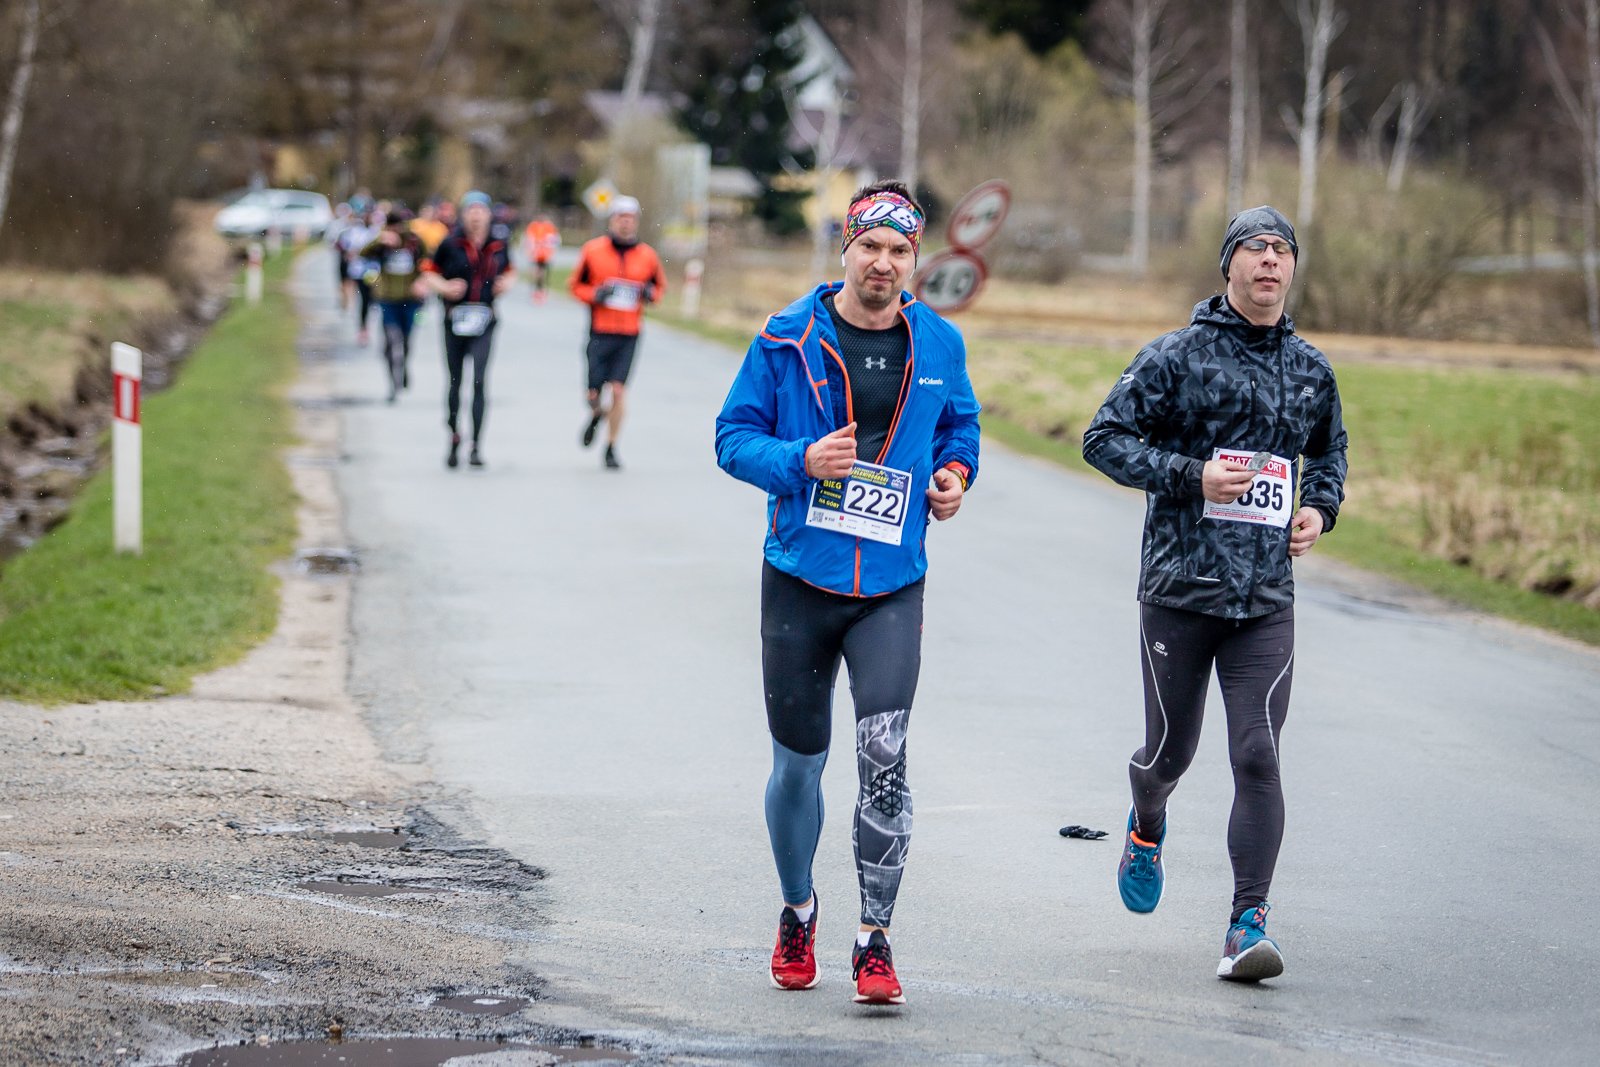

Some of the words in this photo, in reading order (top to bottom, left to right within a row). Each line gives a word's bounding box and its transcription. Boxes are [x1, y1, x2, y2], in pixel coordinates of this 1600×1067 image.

[925, 261, 974, 297] 40
[823, 479, 842, 490] BIEG
[848, 484, 899, 519] 222
